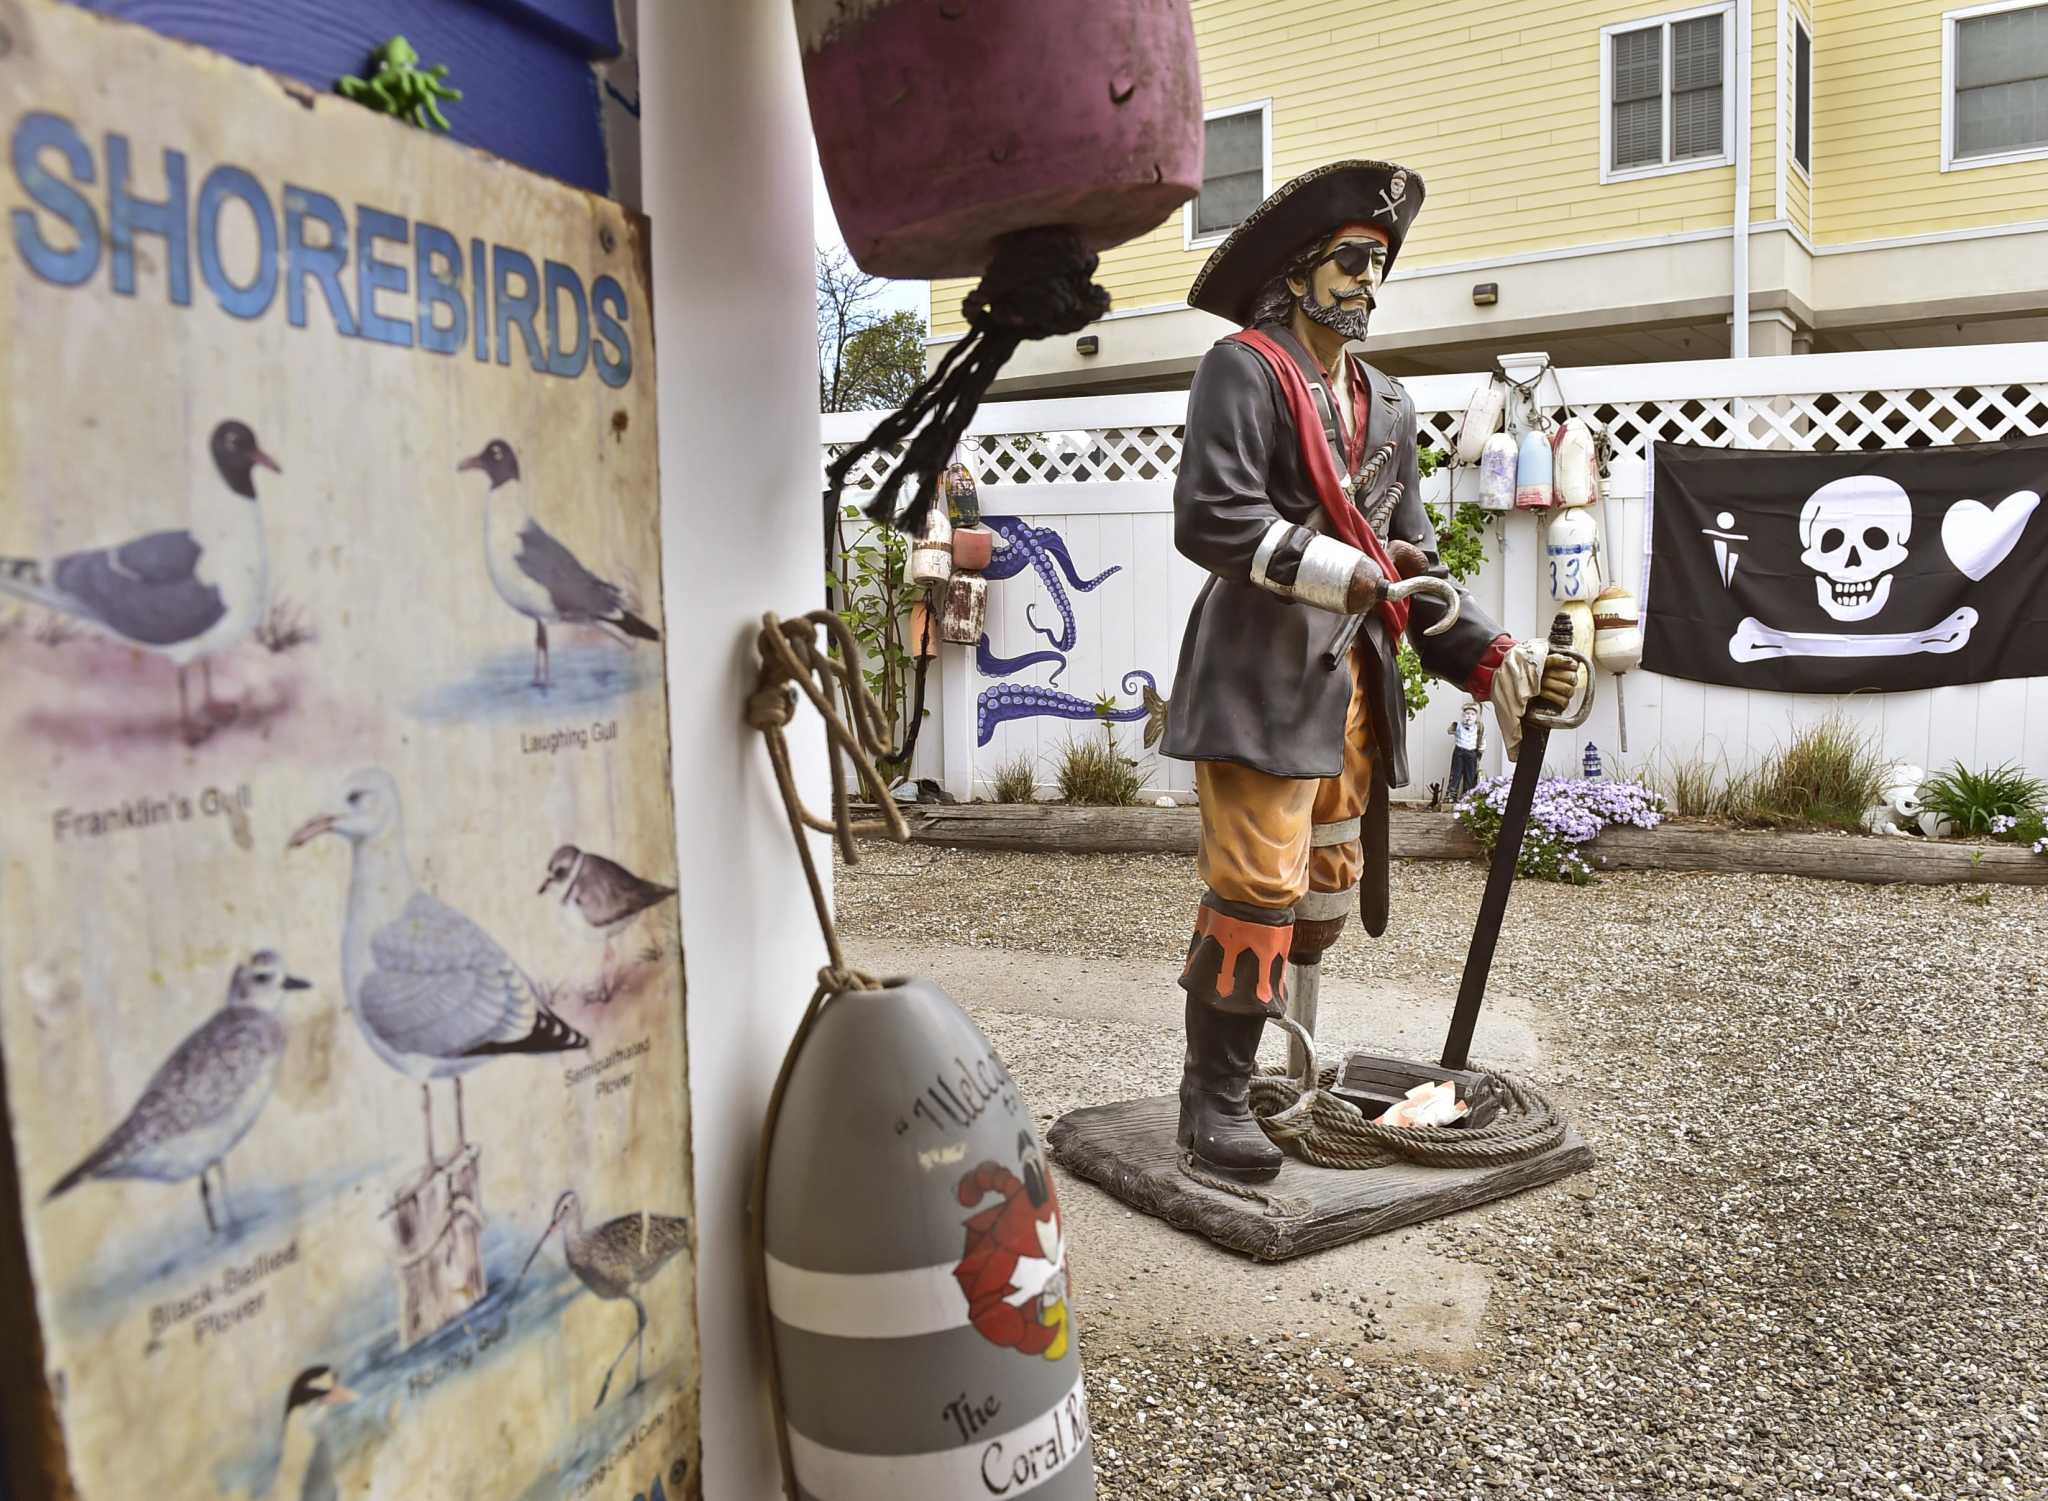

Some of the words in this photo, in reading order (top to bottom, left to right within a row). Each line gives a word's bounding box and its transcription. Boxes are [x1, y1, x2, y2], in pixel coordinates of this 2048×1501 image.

[11, 111, 633, 388] SHOREBIRDS
[520, 727, 588, 755] Laughing
[591, 720, 618, 742] Gull
[52, 793, 193, 842] Franklin's
[193, 1291, 267, 1343] Plover
[942, 1391, 1001, 1443] The
[981, 1410, 1067, 1496] Coral
